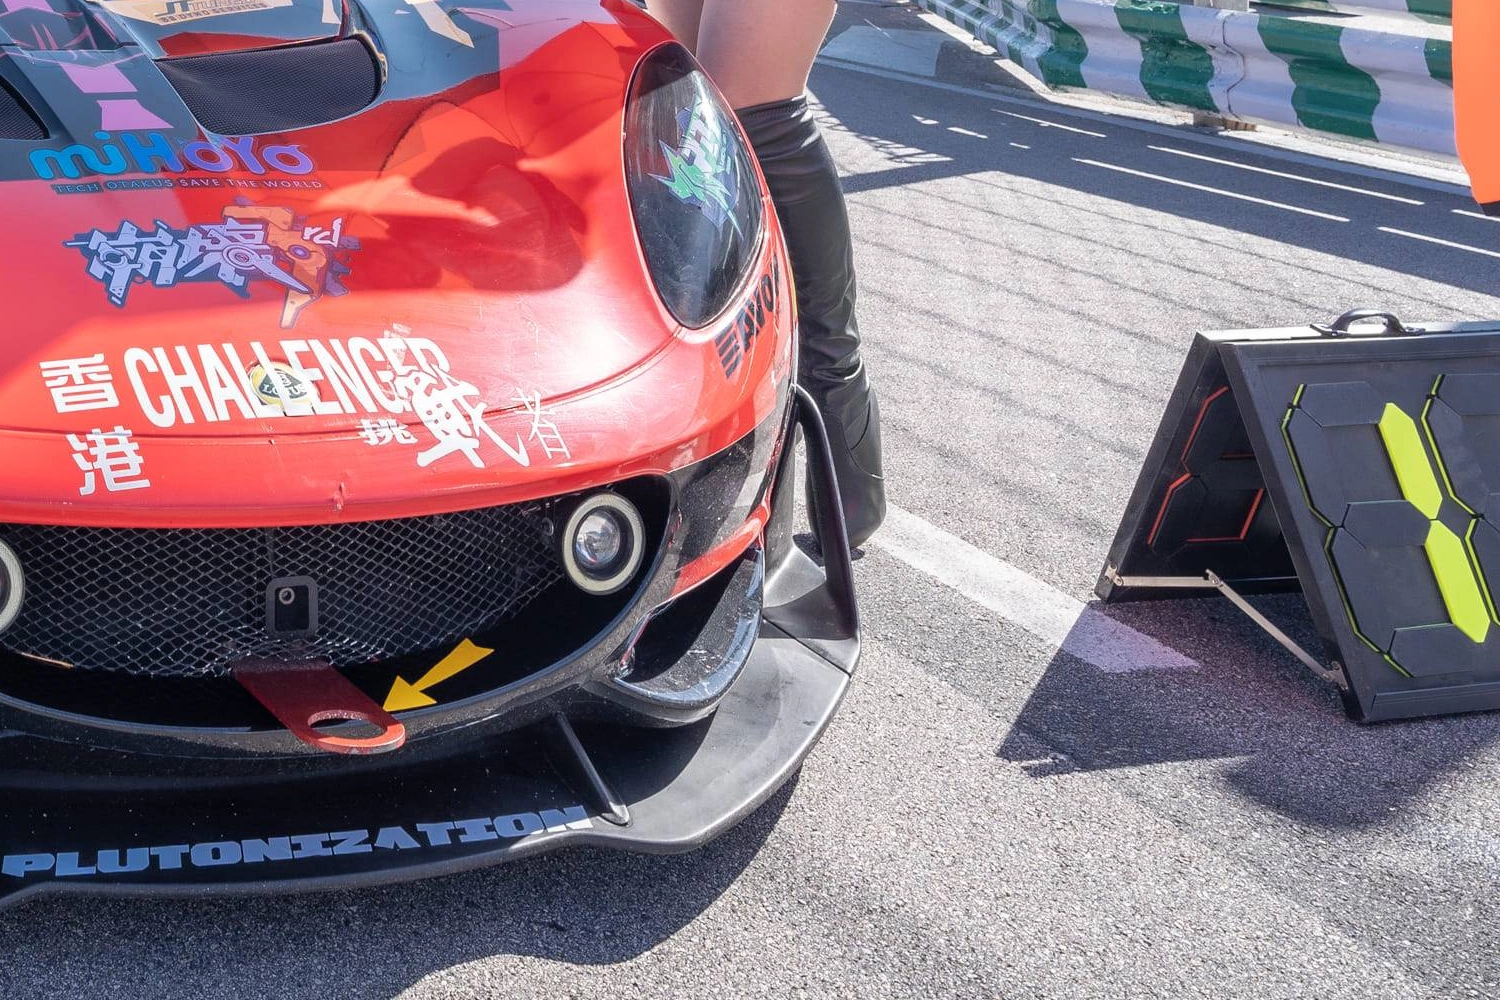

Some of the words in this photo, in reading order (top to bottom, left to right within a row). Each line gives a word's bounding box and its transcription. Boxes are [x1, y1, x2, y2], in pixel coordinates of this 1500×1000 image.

[55, 183, 99, 194] TECH
[107, 178, 174, 190] OTAKUS
[179, 178, 221, 188] SAVE
[227, 178, 259, 189] THE
[263, 179, 323, 190] WORLD
[1, 805, 594, 877] PLUTONIZATION
